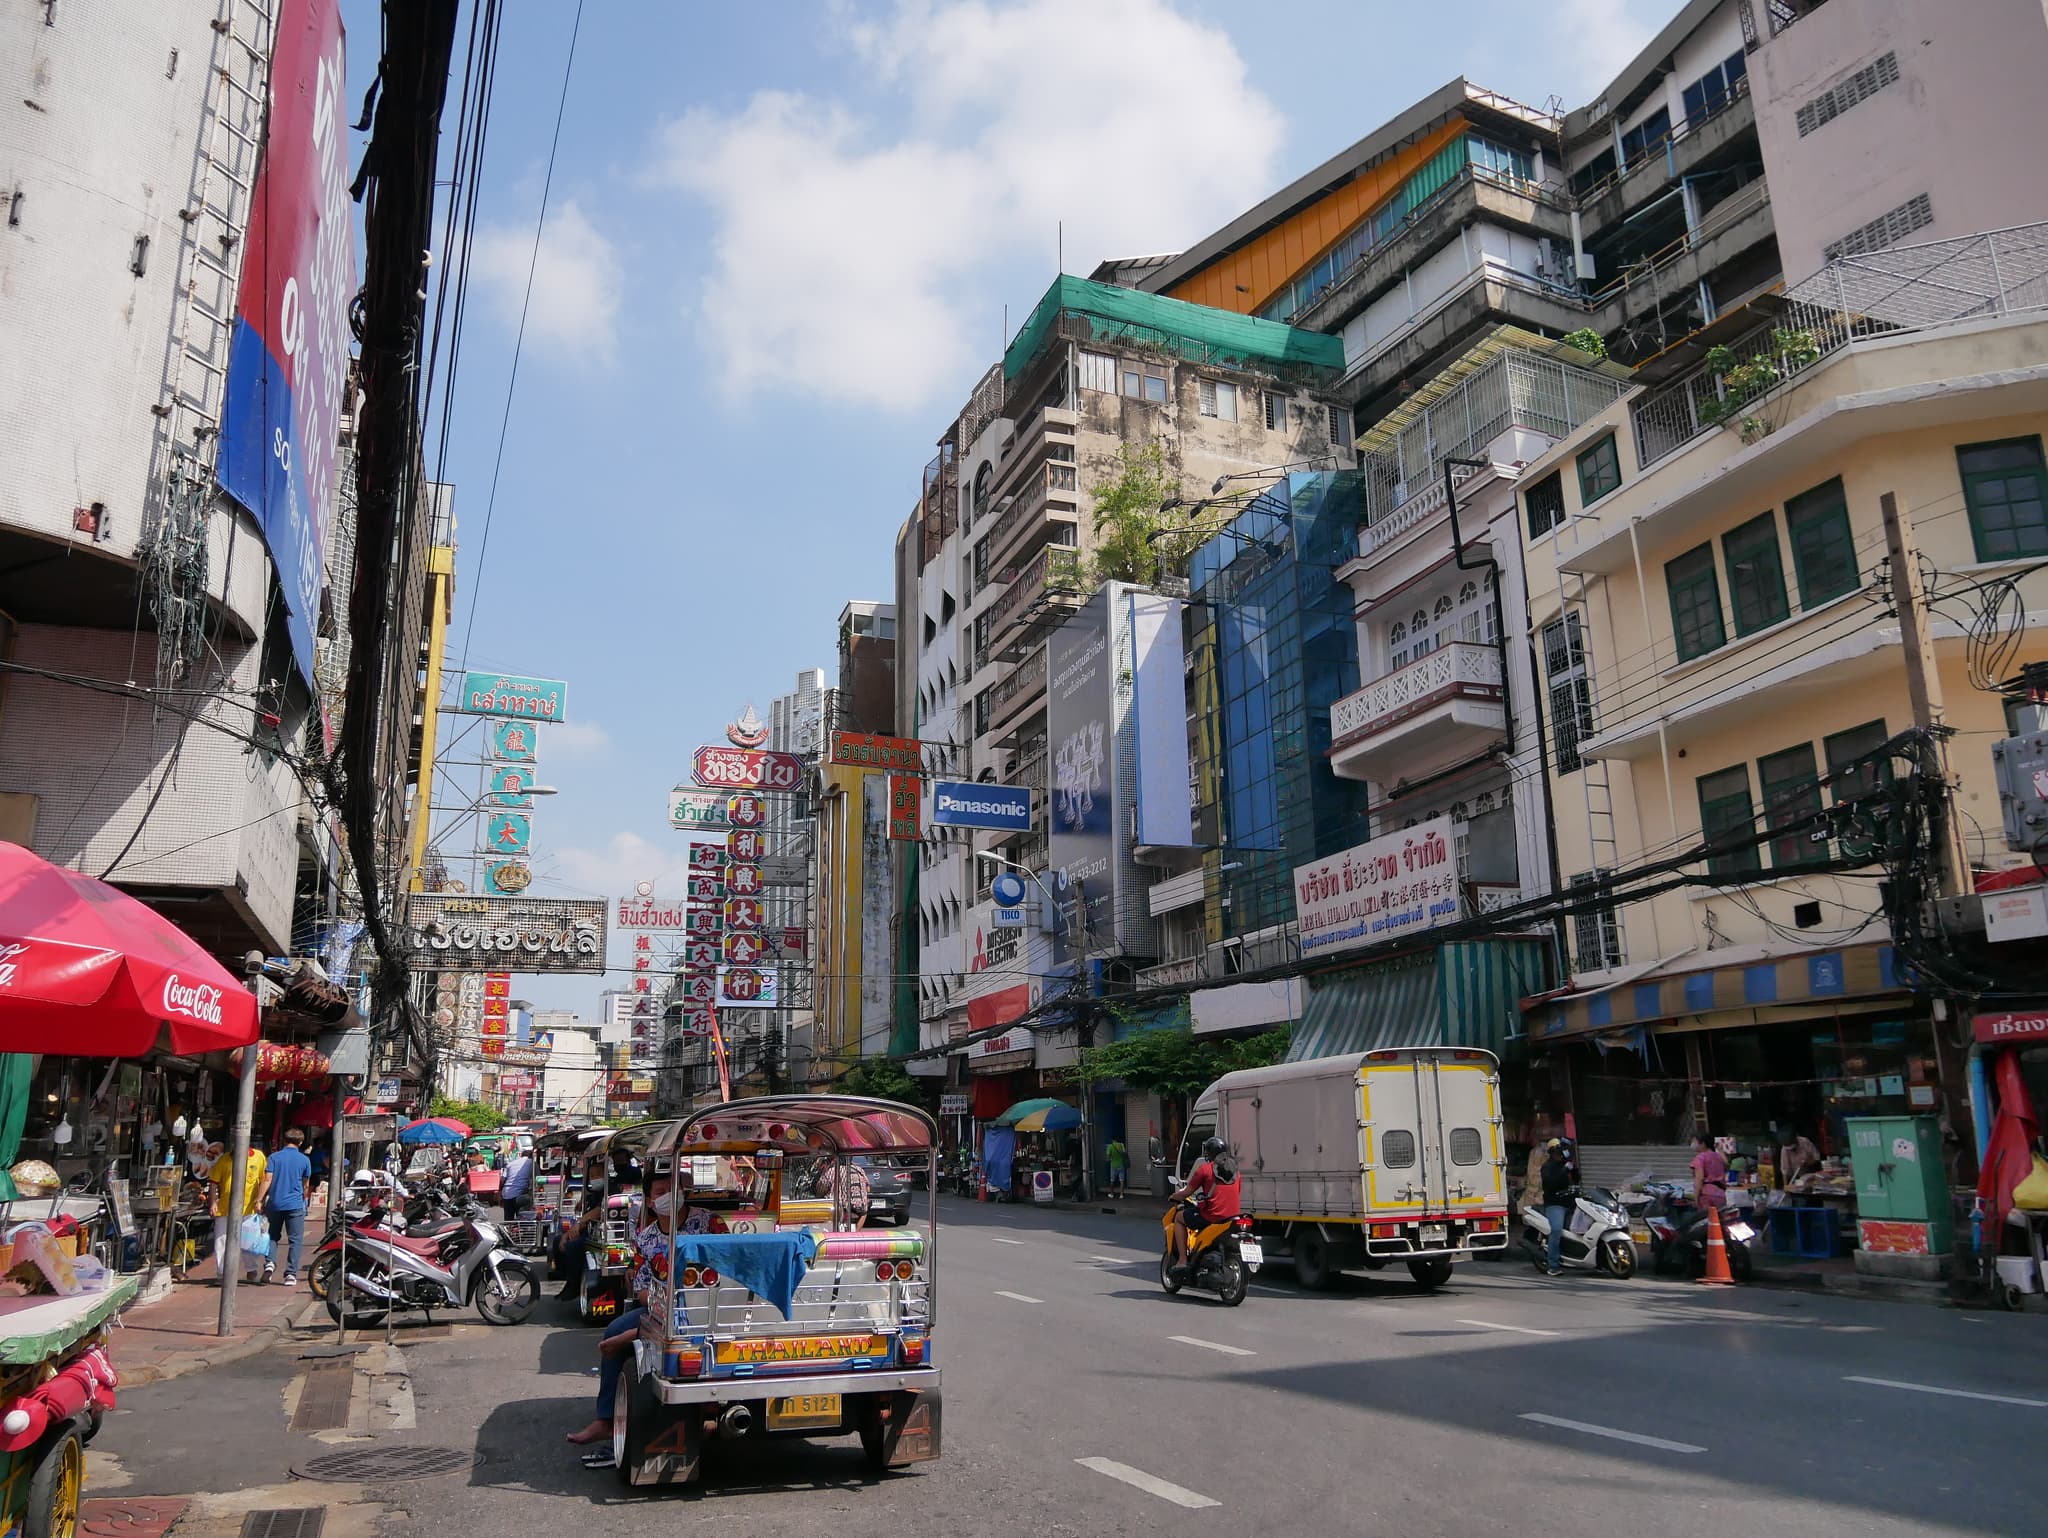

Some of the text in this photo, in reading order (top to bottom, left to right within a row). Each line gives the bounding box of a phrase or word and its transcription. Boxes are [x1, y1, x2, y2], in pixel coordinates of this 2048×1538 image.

[310, 217, 339, 460] ระยะยาว
[281, 275, 309, 413] 081
[305, 375, 321, 498] 701
[472, 689, 558, 716] เล่งหงษ์
[705, 749, 749, 763] ห้างทอง
[833, 734, 919, 767] โรงรับจำนำ
[703, 755, 794, 786] ทองใบ
[938, 795, 1027, 817] Panasonic
[1299, 866, 1340, 905] บริษัท
[1402, 831, 1447, 873] จำกัด
[1001, 910, 1020, 920] TISCO
[691, 847, 716, 1032] 和成興大金行
[735, 1336, 873, 1361] THAILAND
[803, 1395, 837, 1412] 5121
